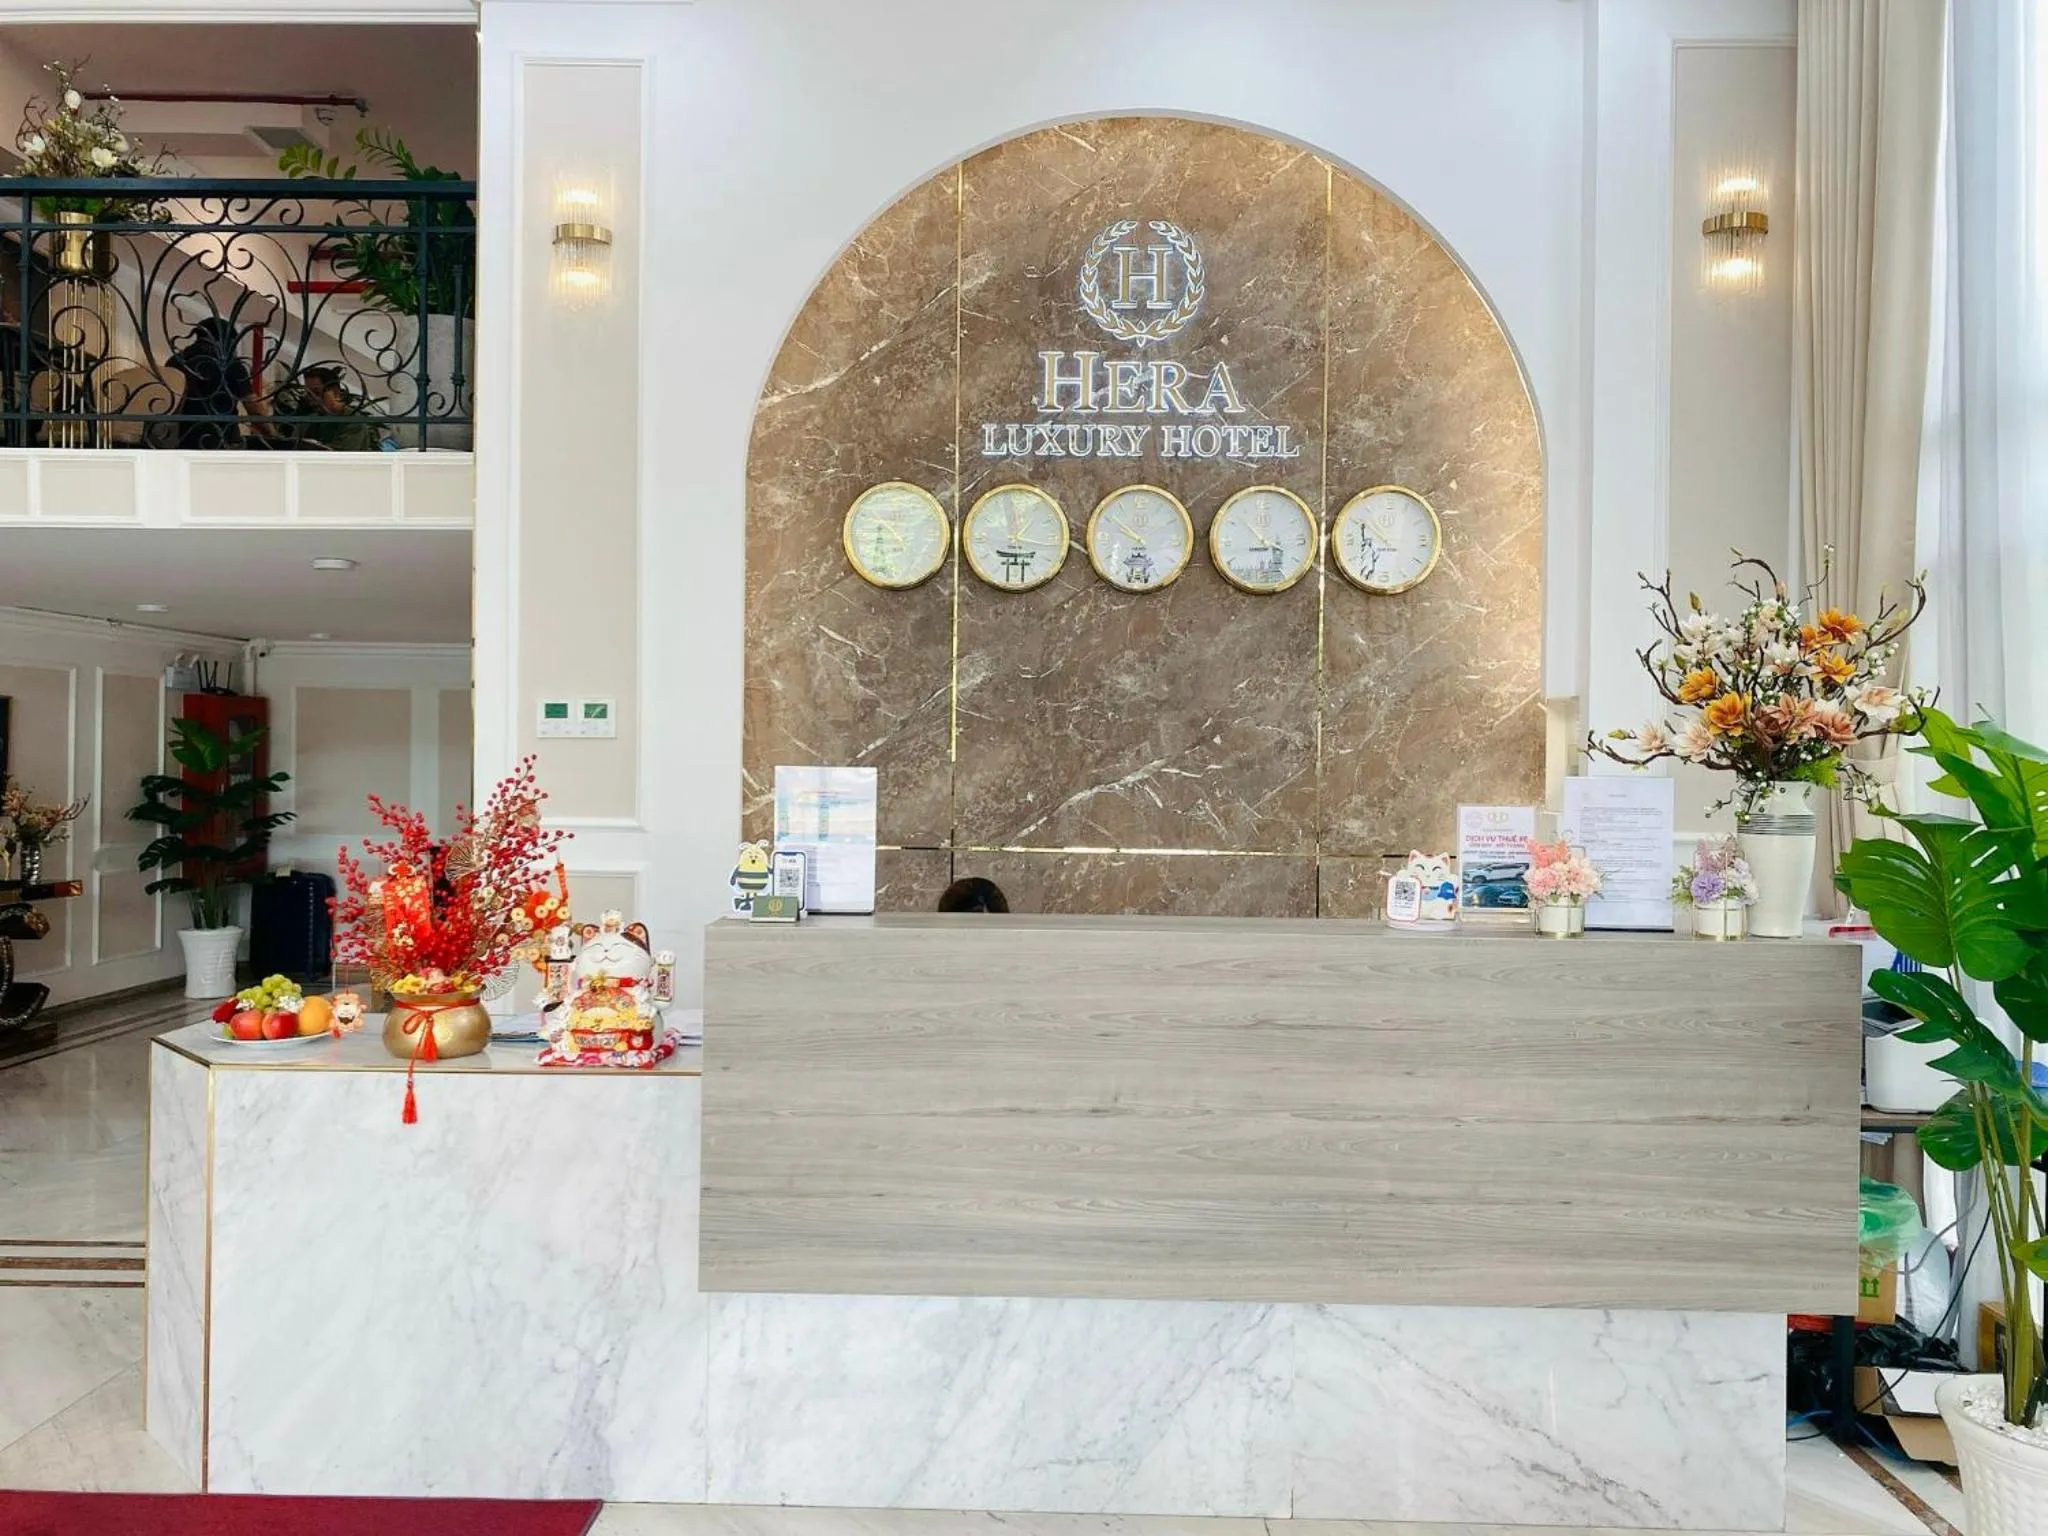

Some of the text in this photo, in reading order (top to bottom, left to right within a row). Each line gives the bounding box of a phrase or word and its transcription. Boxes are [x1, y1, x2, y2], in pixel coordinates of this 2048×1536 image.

[1112, 244, 1174, 309] H
[1037, 351, 1246, 414] HERA
[982, 423, 1300, 458] LUXURY HOTEL
